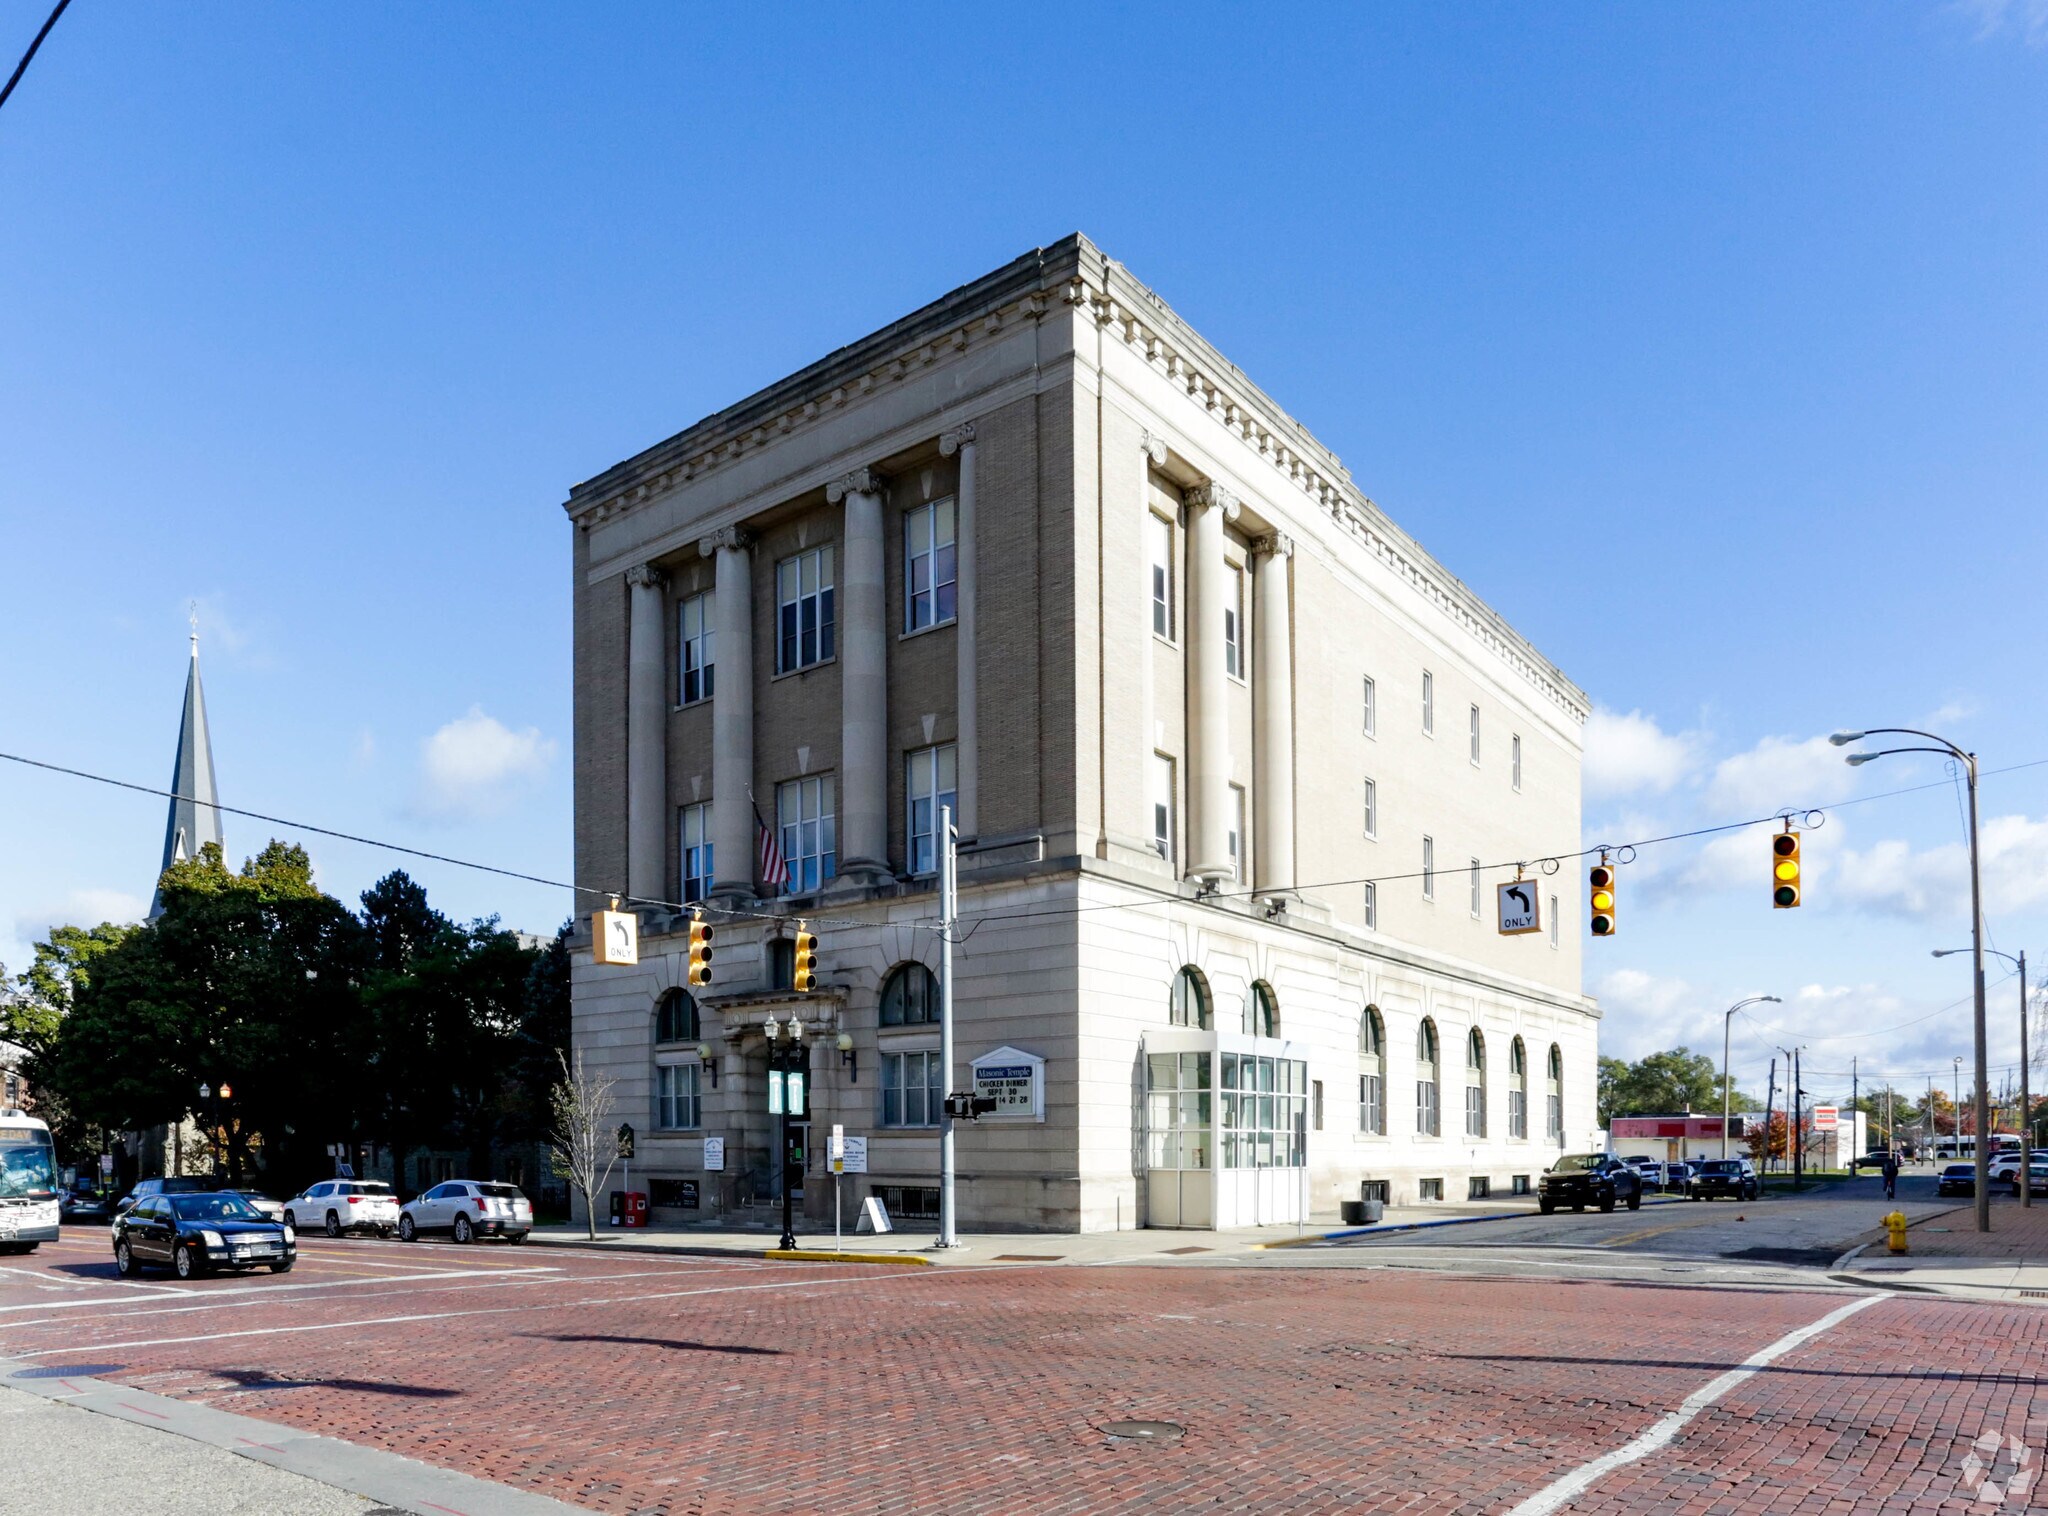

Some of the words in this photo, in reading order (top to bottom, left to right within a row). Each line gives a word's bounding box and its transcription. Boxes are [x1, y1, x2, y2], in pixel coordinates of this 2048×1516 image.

[1504, 916, 1532, 928] ONLY
[611, 947, 632, 958] ONLY
[979, 1069, 1005, 1078] Masonic
[1007, 1067, 1031, 1078] Temple
[1006, 1079, 1028, 1087] DINNER
[988, 1088, 1002, 1096] SEPT
[1008, 1088, 1017, 1096] 30
[1020, 1096, 1028, 1104] 28
